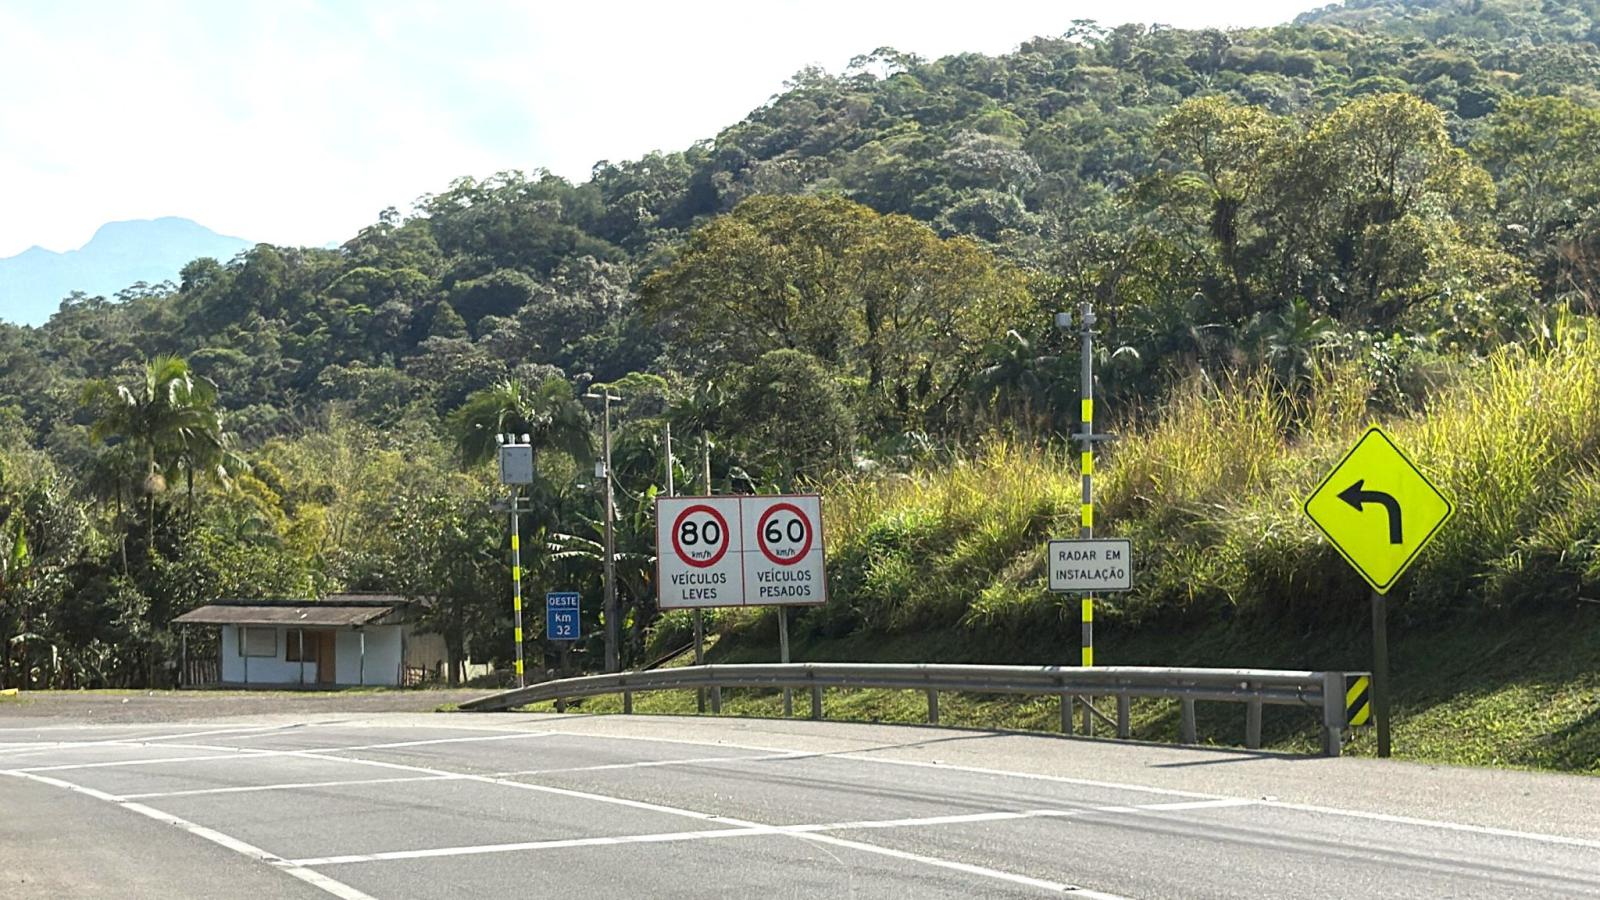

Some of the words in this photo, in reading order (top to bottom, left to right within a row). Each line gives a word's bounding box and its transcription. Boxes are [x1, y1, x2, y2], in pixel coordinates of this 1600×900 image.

[681, 520, 720, 546] 80
[765, 518, 804, 544] 60
[691, 549, 712, 559] km/h
[775, 547, 796, 557] km/h
[1059, 550, 1096, 561] RADAR
[1105, 550, 1120, 560] EM
[671, 570, 727, 585] VEÍCULOS
[757, 567, 812, 582] VEÍCULOS
[1056, 566, 1124, 582] INSTALAÇÃO
[682, 587, 717, 600] LEVES
[759, 585, 811, 597] PESADOS
[549, 596, 577, 606] OESTE
[555, 613, 571, 623] km
[556, 625, 571, 635] 32
